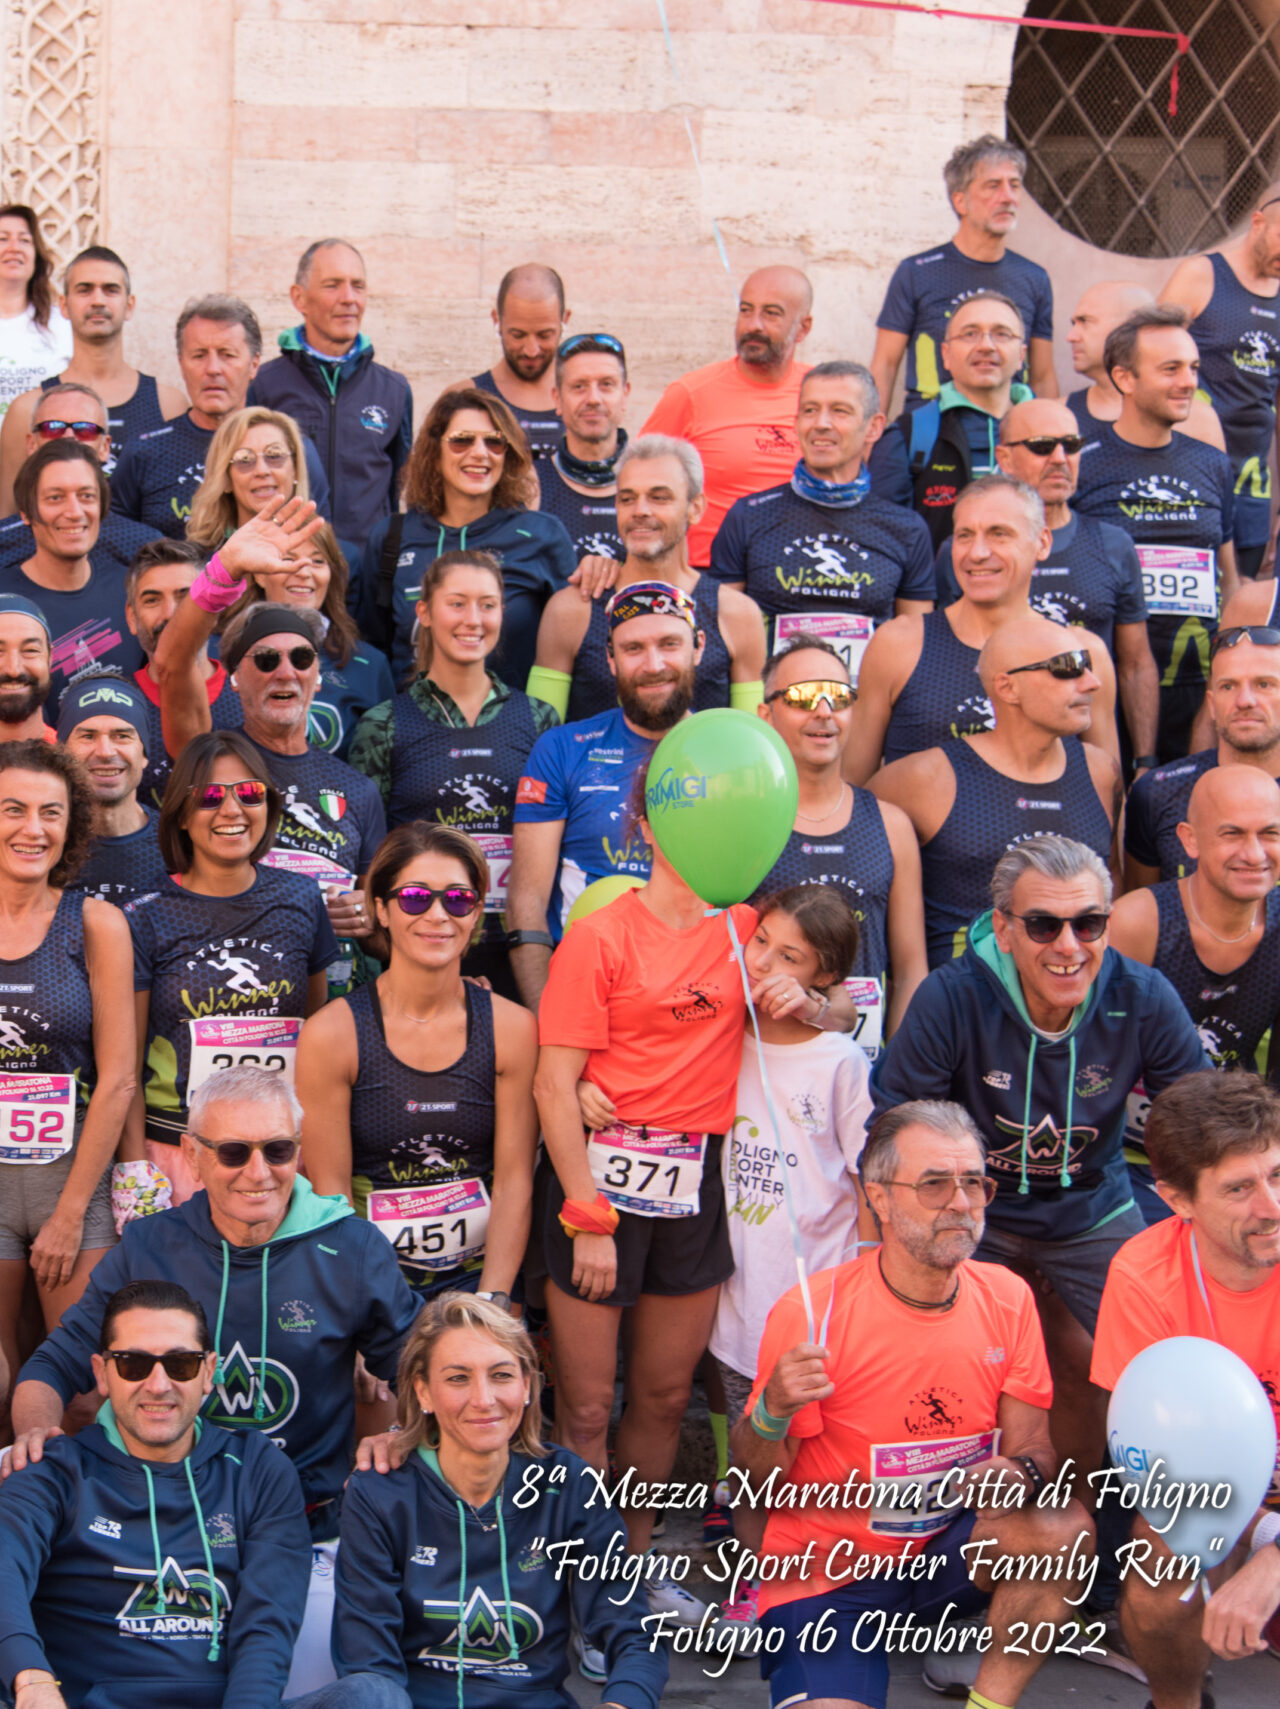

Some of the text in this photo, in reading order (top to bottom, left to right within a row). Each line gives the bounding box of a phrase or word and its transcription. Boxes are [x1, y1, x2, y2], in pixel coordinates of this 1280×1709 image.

[1120, 475, 1199, 499] ATLETICA
[783, 533, 869, 561] ATLETICA
[774, 565, 875, 592] Winner
[790, 586, 861, 599] FOLIGNO
[319, 788, 345, 798] ITALIA
[437, 773, 509, 797] ATLETICA
[646, 768, 707, 812] RIMIGI
[435, 804, 510, 830] Winner
[276, 834, 338, 859] OLIGNO
[186, 937, 284, 970] ATLETICA
[180, 980, 295, 1018] Winner
[733, 1141, 798, 1167] OLIGNO
[985, 1156, 1012, 1171] ALL
[389, 1158, 469, 1183] Winner
[604, 1155, 680, 1197] 371
[393, 1218, 467, 1255] 451
[909, 1387, 963, 1406] ATLETICA
[894, 1479, 951, 1516] 42
[119, 1617, 224, 1633] ALL AROUND
